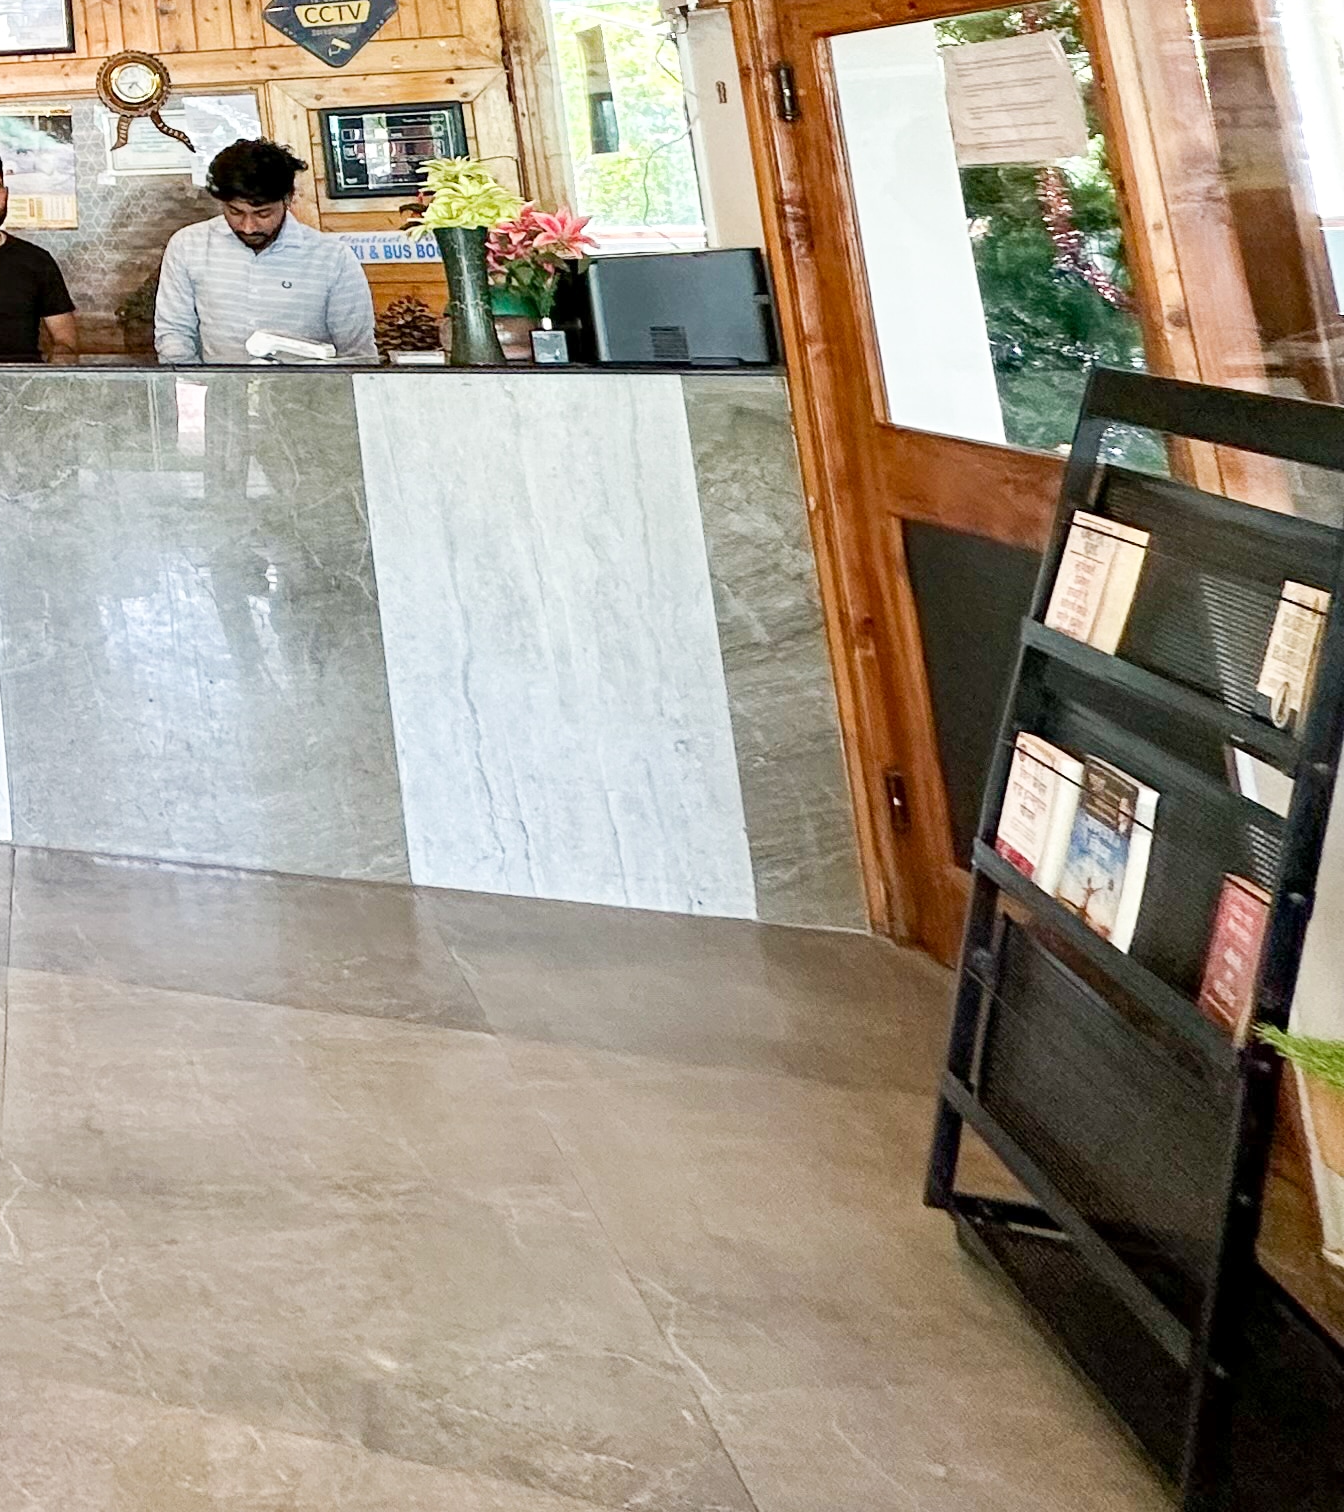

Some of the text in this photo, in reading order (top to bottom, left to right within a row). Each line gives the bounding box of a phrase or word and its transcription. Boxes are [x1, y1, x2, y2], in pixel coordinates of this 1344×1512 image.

[304, 3, 362, 24] CCTV
[350, 245, 364, 260] XI
[369, 245, 379, 260] &
[383, 244, 412, 260] BUS
